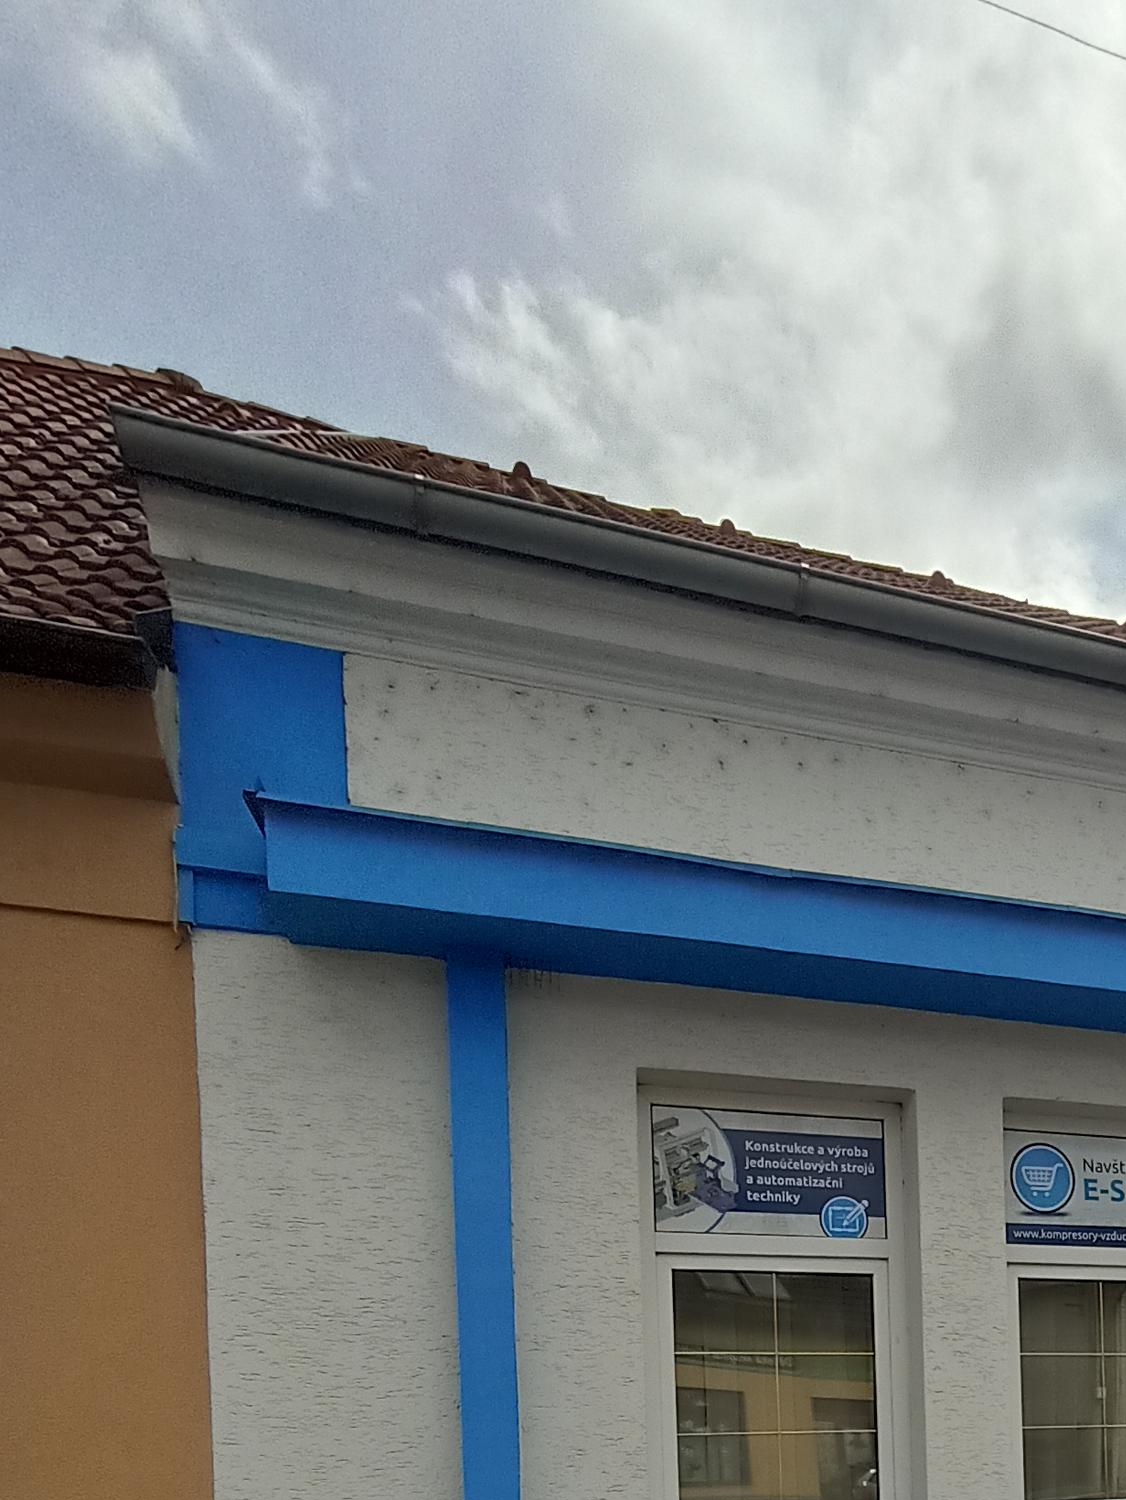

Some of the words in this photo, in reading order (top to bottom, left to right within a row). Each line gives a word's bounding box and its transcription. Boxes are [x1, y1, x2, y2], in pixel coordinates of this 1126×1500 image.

[744, 1140, 815, 1155] Konstrukce
[817, 1145, 825, 1155] a
[827, 1144, 869, 1159] výroba
[744, 1156, 838, 1174] jednoúčelových
[840, 1162, 876, 1177] strojů
[746, 1175, 754, 1185] a
[746, 1190, 801, 1206] techniky
